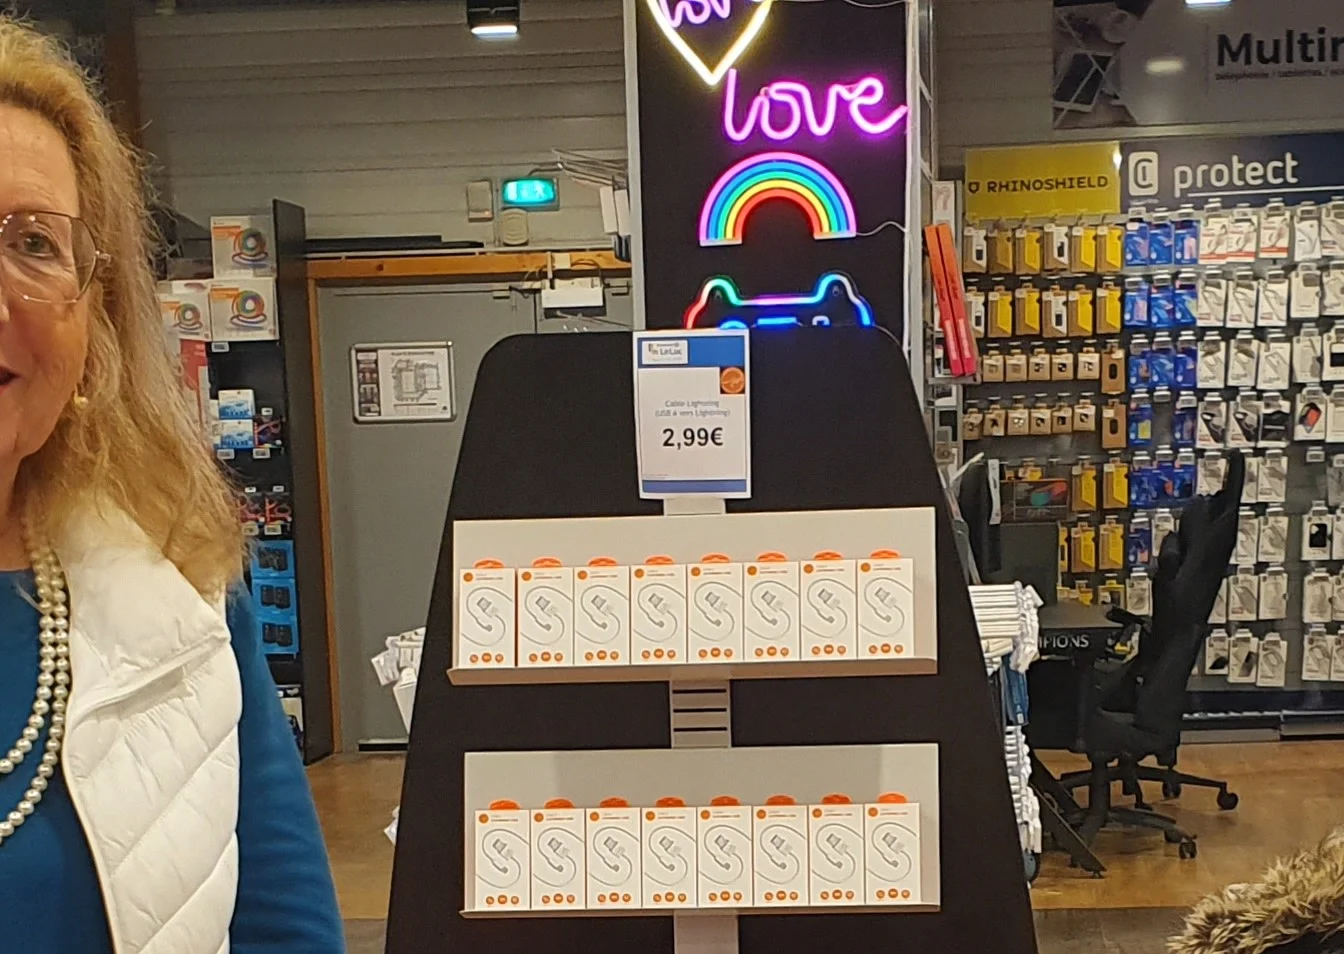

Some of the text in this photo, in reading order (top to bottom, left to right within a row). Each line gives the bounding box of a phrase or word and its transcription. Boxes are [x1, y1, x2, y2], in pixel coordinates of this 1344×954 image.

[724, 68, 909, 141] love
[986, 174, 1109, 197] RHINOSHIELD
[1174, 152, 1299, 193] protect
[662, 427, 724, 450] 2,99€
